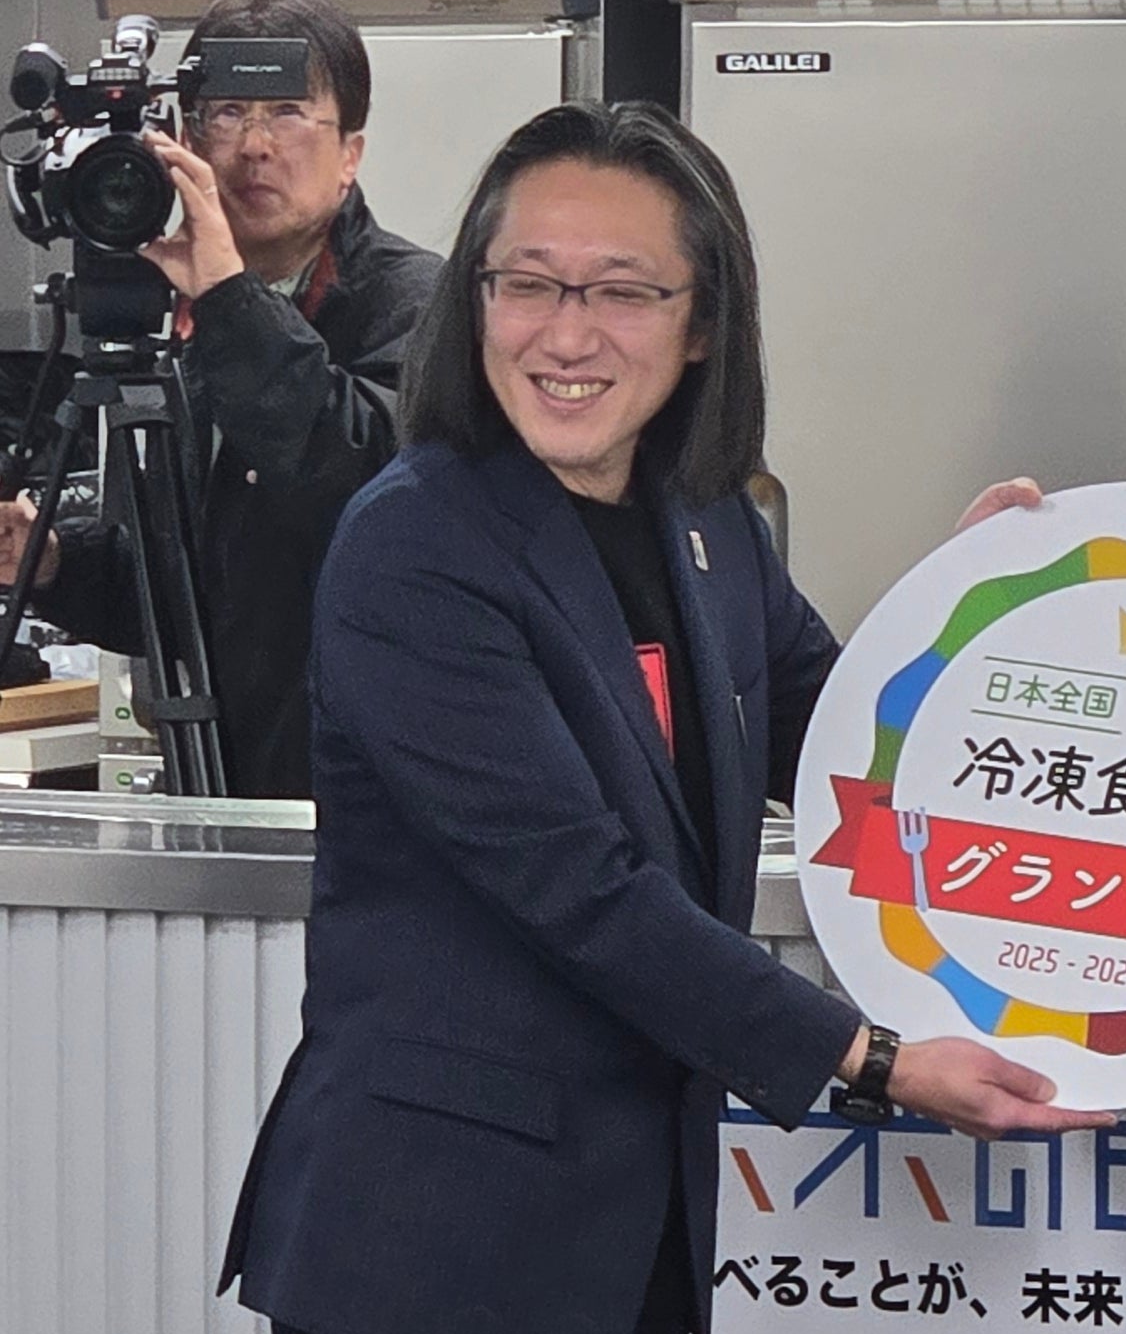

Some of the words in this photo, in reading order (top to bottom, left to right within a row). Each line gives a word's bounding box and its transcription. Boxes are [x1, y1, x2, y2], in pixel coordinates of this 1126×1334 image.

[725, 54, 821, 71] GALILEI
[985, 672, 1118, 719] 日本全国
[998, 941, 1060, 974] 2025
